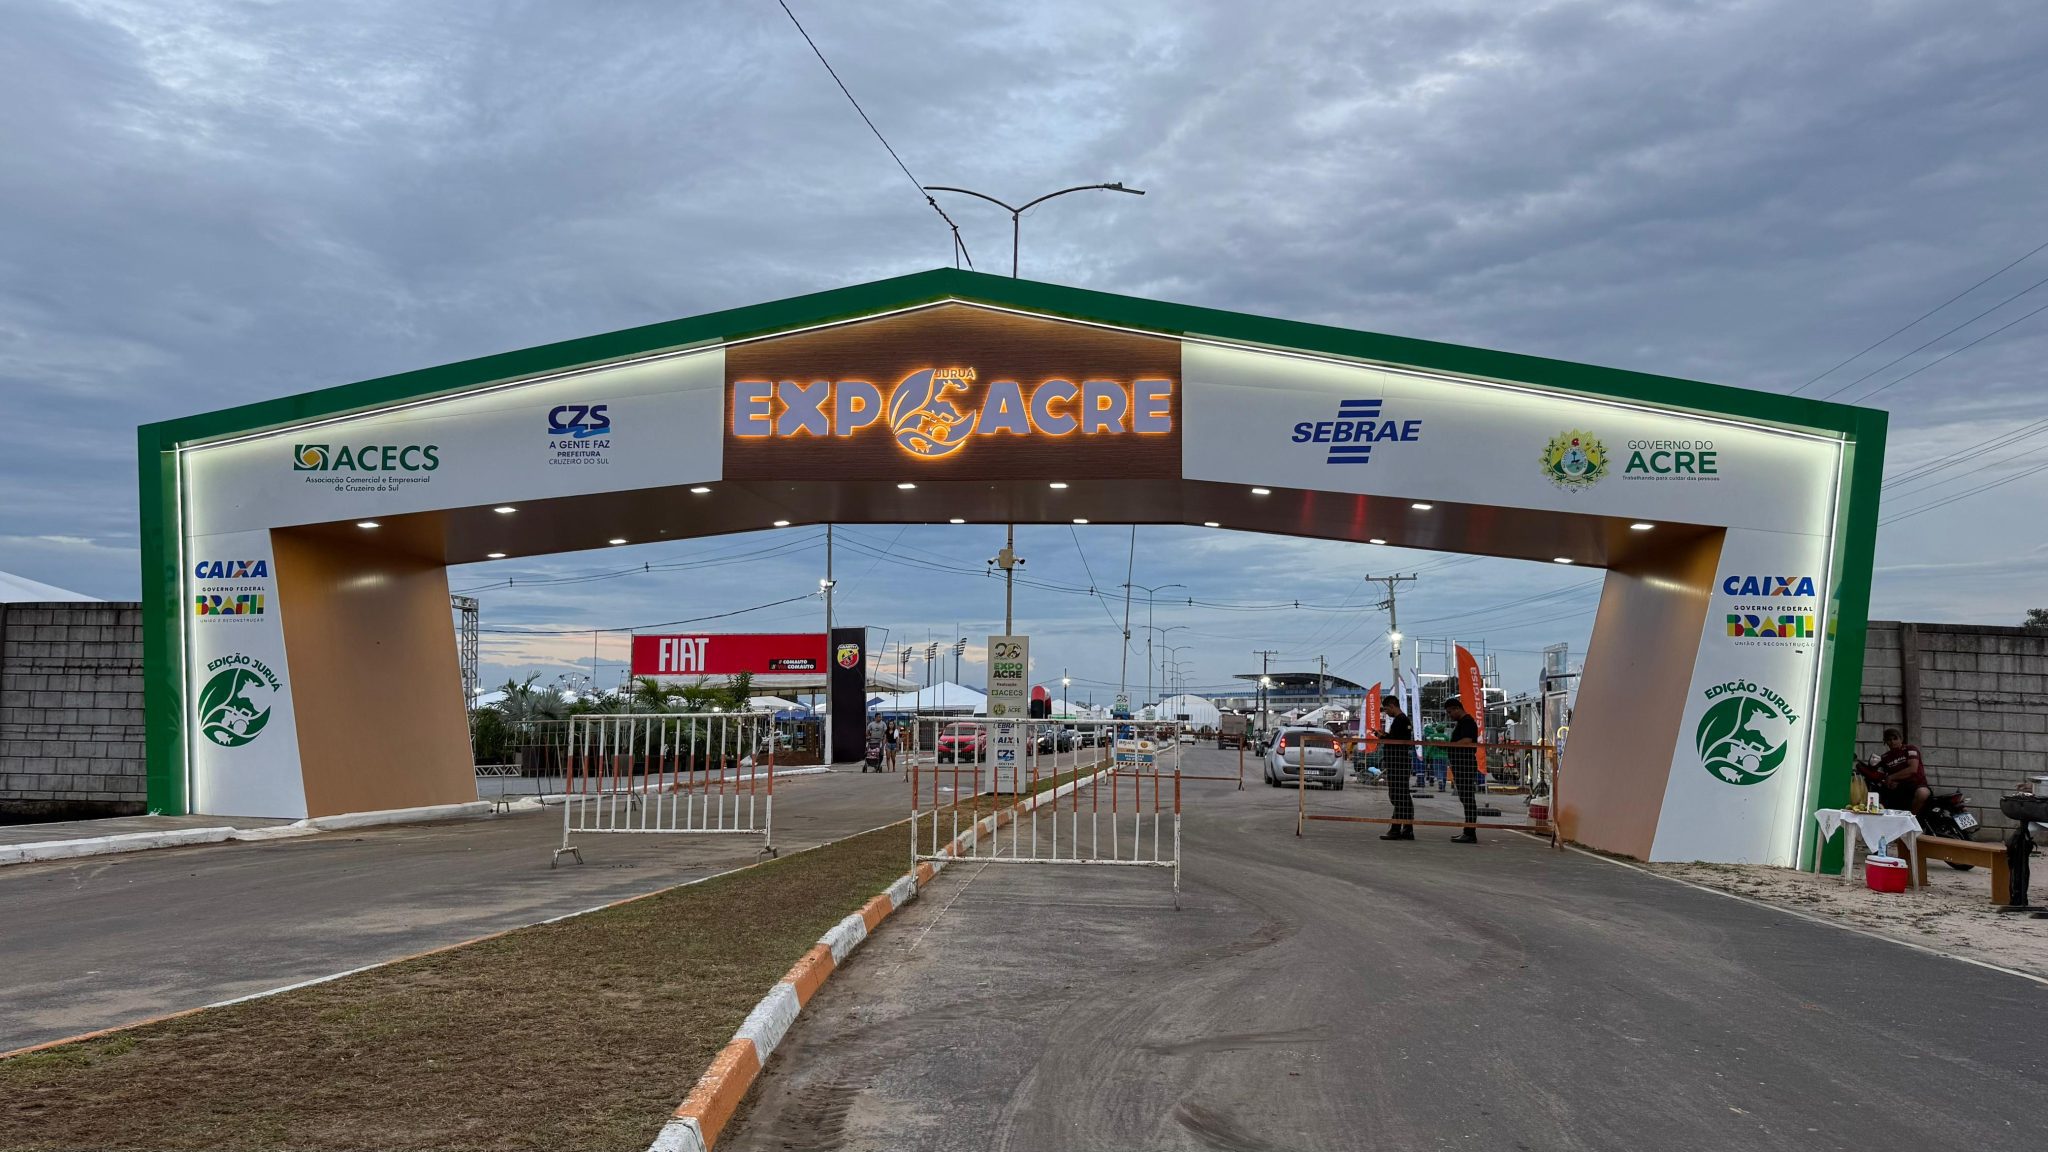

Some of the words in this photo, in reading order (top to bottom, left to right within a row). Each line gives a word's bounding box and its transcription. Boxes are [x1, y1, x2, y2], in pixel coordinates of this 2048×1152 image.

[548, 405, 610, 430] CZS
[1291, 420, 1422, 443] SEBRAE
[549, 441, 556, 449] A
[559, 441, 590, 449] GENTE
[593, 440, 610, 449] FAZ
[1627, 440, 1691, 450] GOVERNO
[1695, 440, 1713, 450] DO
[331, 444, 440, 472] ACECS
[1625, 451, 1718, 474] ACRE
[305, 476, 344, 484] Associação
[388, 476, 430, 484] Empresarial
[195, 560, 268, 579] CAIXA
[1723, 576, 1815, 596] CAIXA
[658, 638, 709, 672] FIAT
[993, 662, 1023, 670] EXPO
[207, 653, 250, 671] EDIÇÃO
[252, 659, 282, 692] JURUÁ
[993, 670, 1022, 678] ACRE
[1470, 667, 1482, 728] energisa
[1704, 679, 1757, 700] EDIÇÃO
[1759, 687, 1800, 725] JURUÁ
